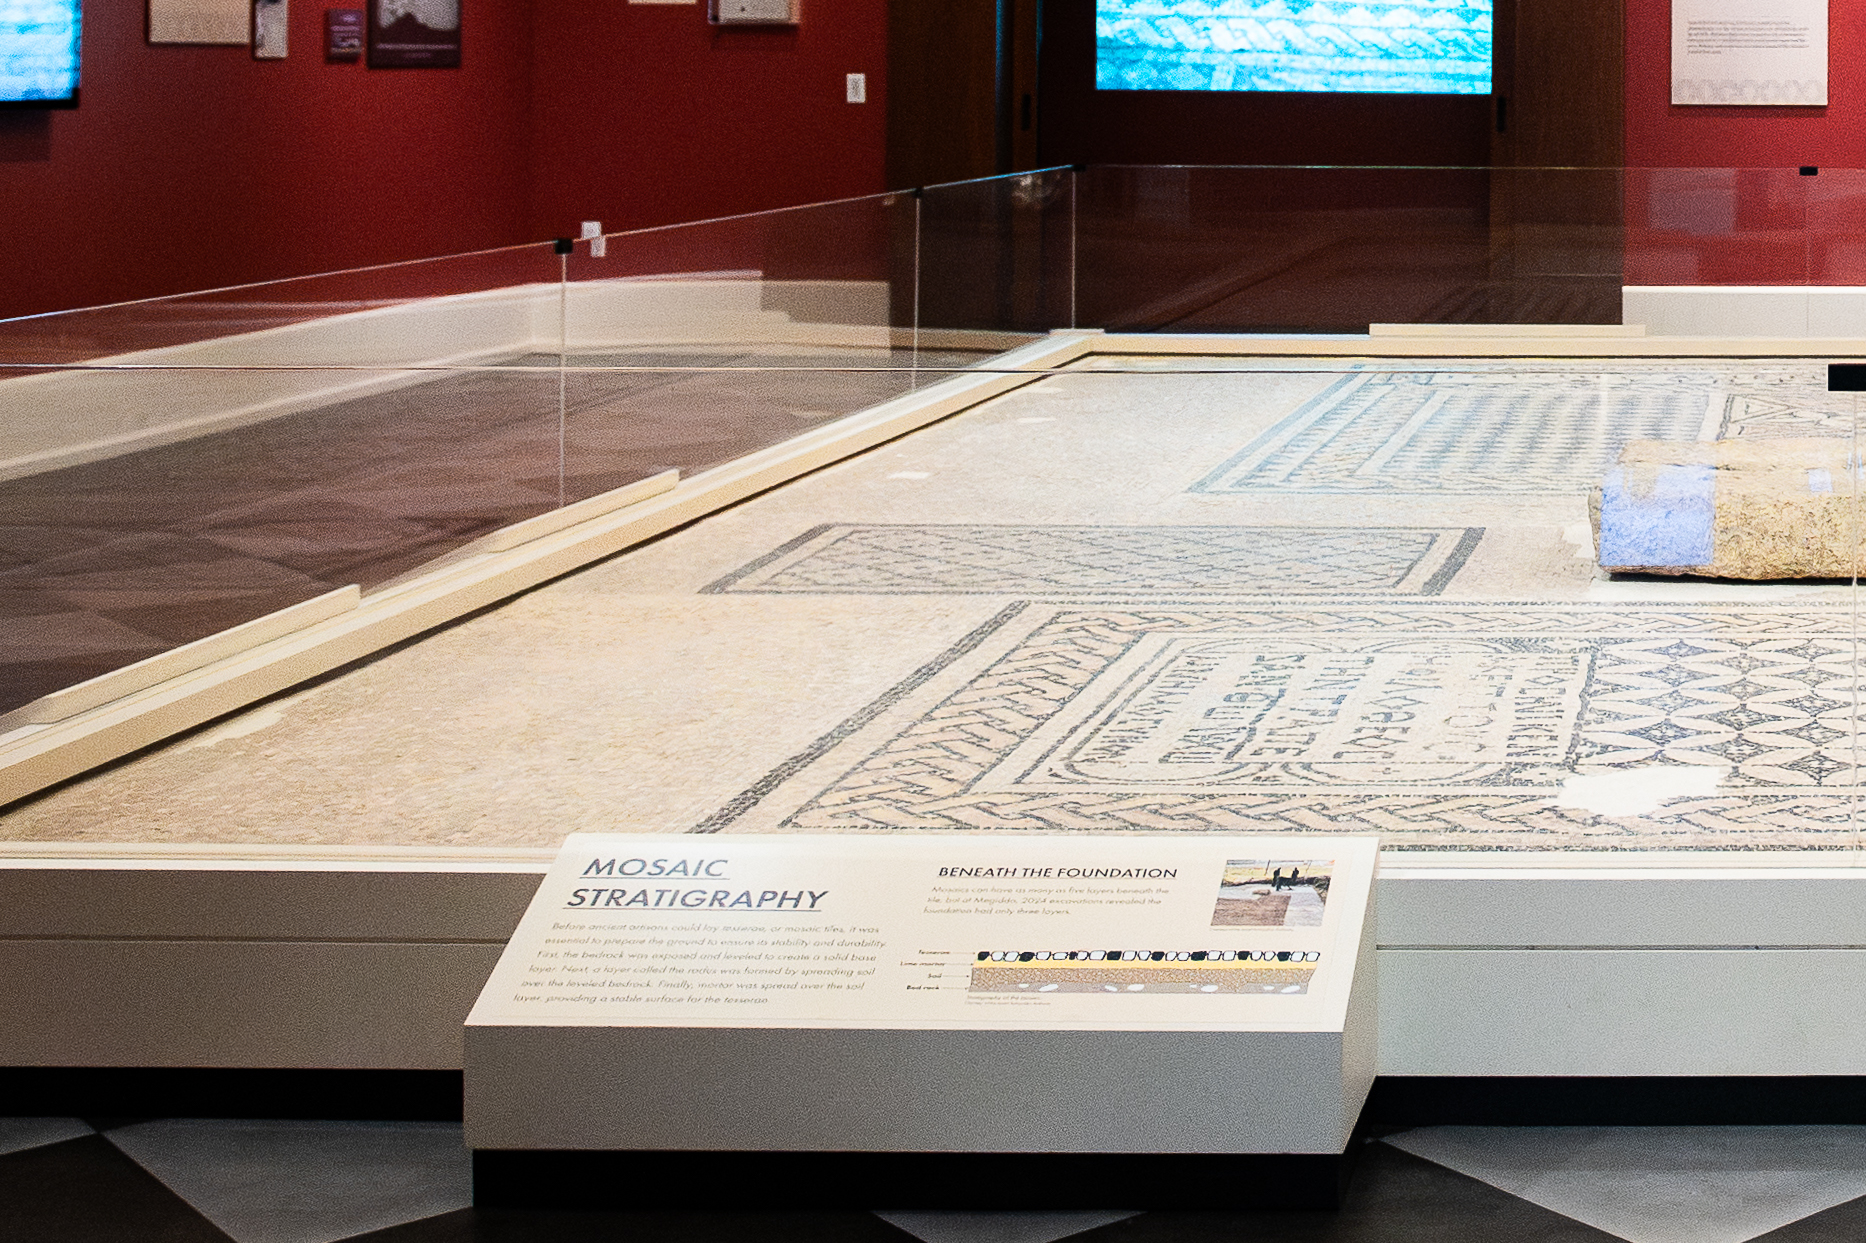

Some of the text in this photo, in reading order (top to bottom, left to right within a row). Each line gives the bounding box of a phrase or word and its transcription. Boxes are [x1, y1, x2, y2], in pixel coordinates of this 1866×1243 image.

[583, 858, 728, 877] MOSAIC
[939, 867, 1178, 878] BENEATH THE FOUNDATION
[567, 888, 829, 909] STRATIGRAPHY
